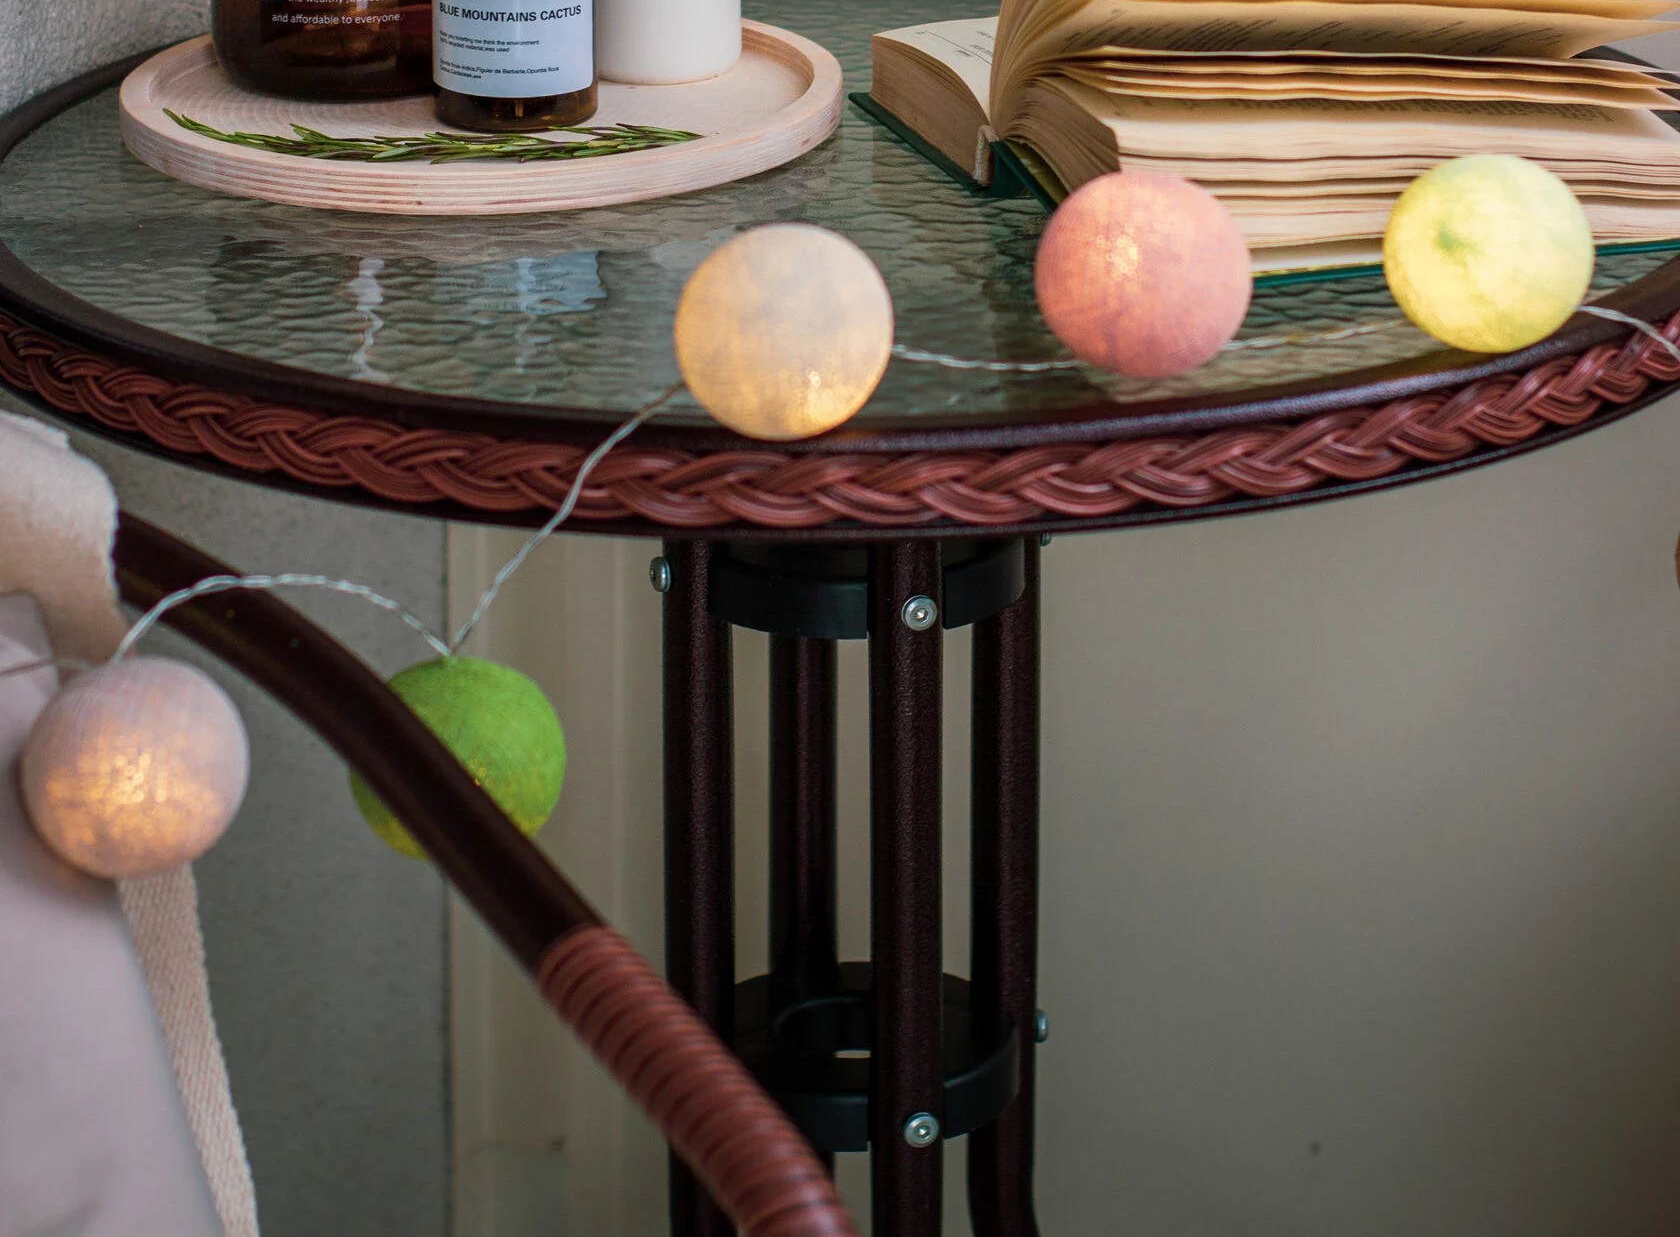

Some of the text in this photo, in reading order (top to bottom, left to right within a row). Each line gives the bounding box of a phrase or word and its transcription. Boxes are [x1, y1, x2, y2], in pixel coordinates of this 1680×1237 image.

[272, 12, 288, 22] and
[290, 14, 339, 24] affordable
[342, 15, 352, 24] to
[440, 2, 581, 21] BLUE MOUNTAINS CACTUS
